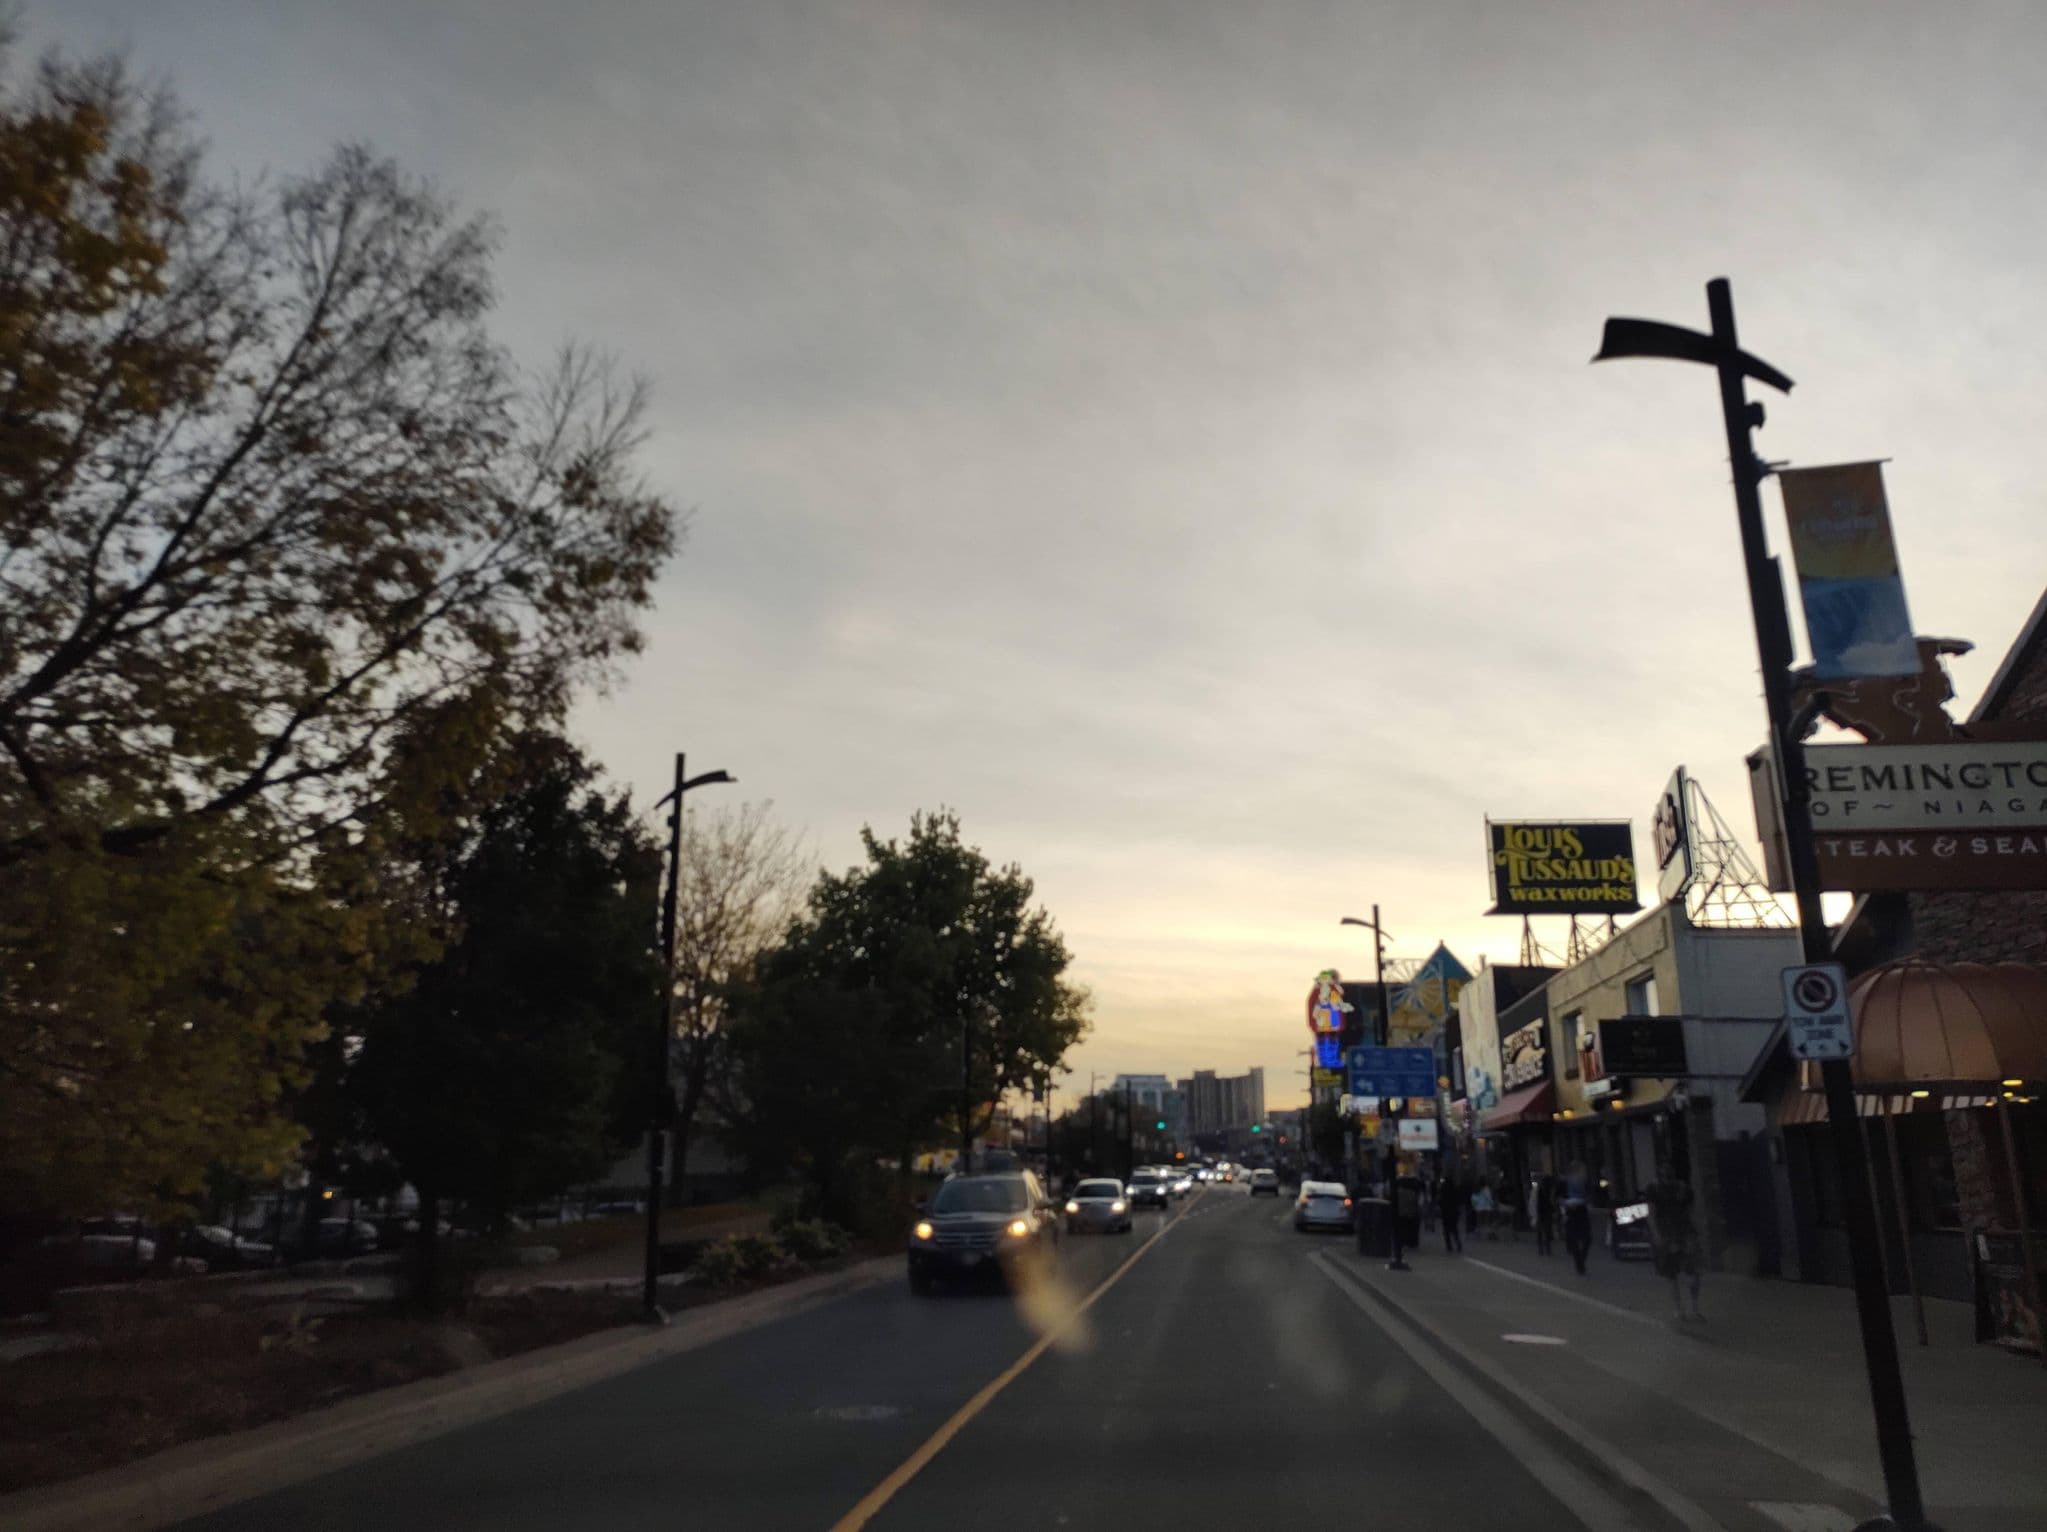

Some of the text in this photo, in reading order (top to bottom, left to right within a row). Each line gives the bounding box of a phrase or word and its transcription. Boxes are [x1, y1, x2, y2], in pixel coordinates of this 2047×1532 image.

[1804, 761, 2047, 793] REMINGTO
[1812, 799, 1859, 816] OF
[1503, 824, 1584, 859] LOUIS
[1816, 839, 1919, 857] TEAK
[1932, 836, 1957, 857] &
[1495, 850, 1634, 886] TUSSAUD'S
[1508, 882, 1633, 901] waxworks
